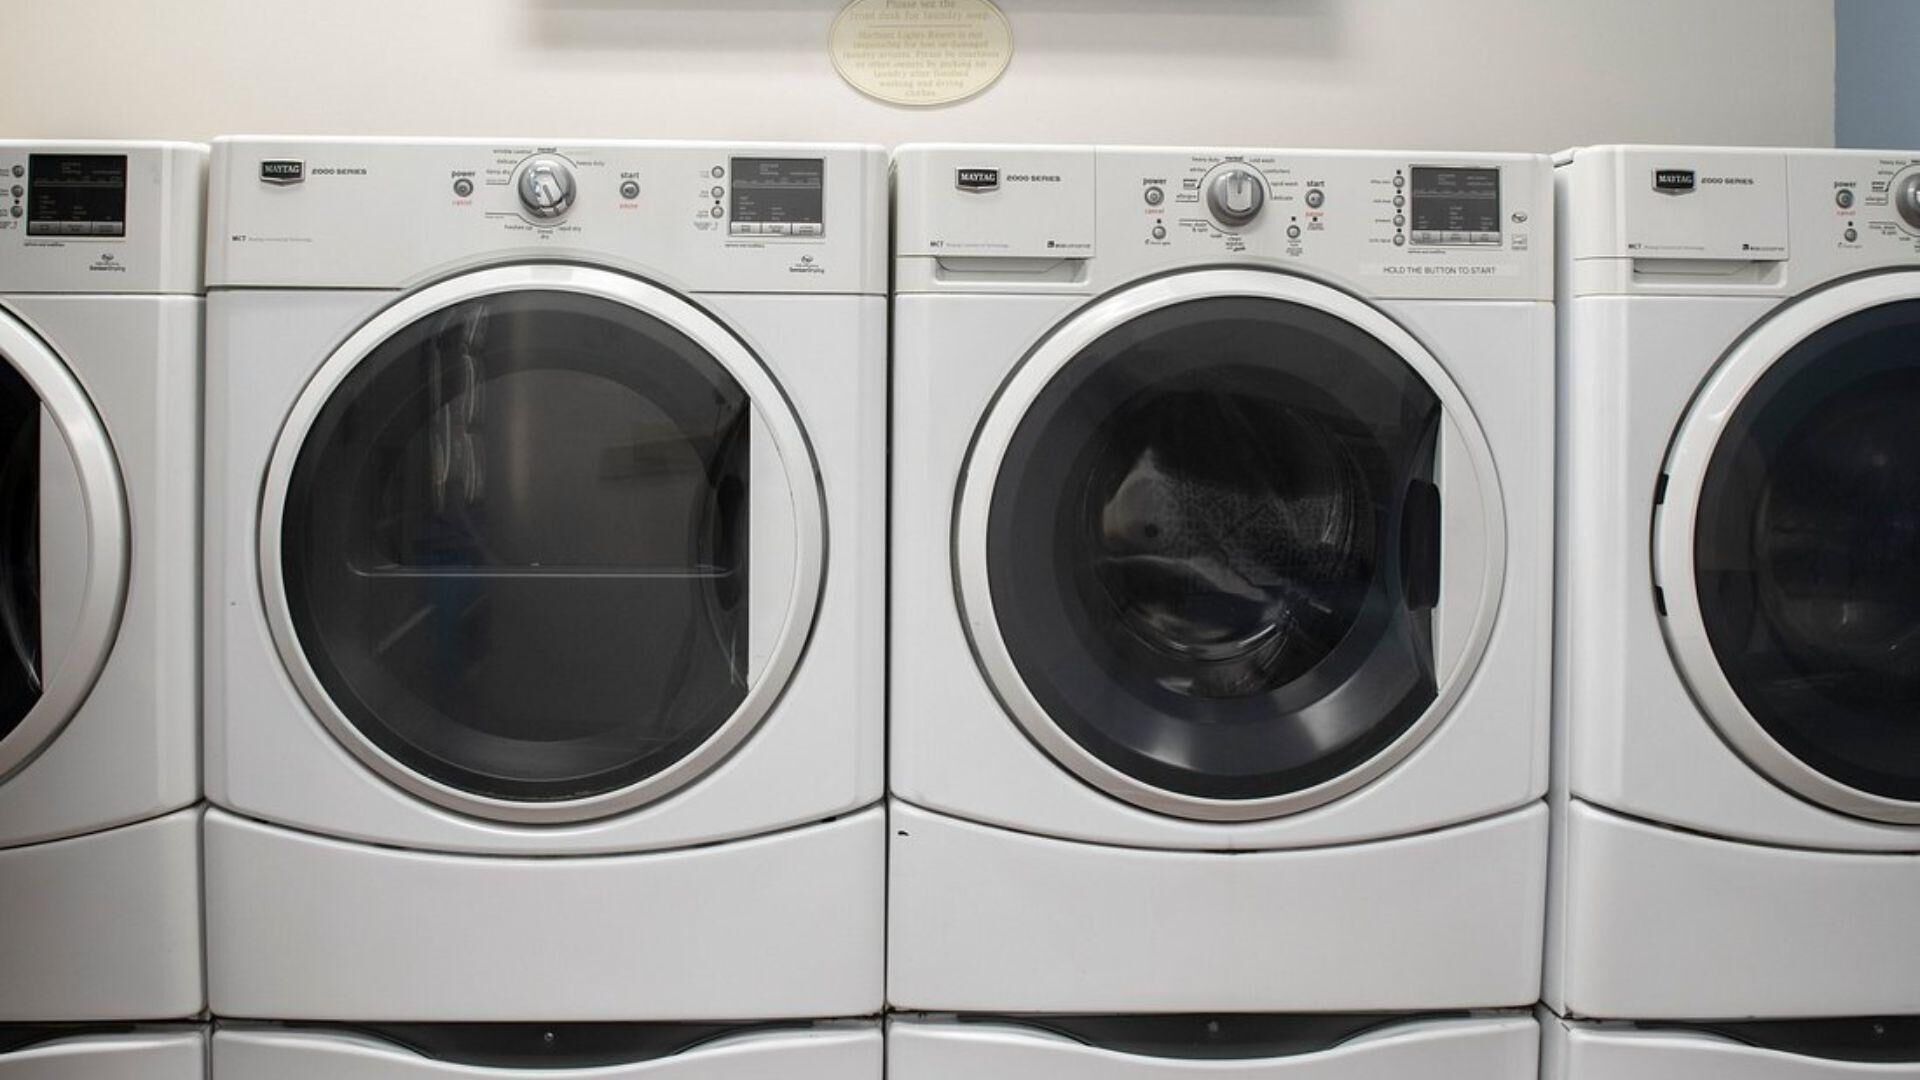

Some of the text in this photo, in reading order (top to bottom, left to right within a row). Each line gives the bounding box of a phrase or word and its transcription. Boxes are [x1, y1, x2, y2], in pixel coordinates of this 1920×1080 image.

[264, 165, 300, 174] MAYTAG
[451, 171, 475, 179] power
[961, 173, 996, 181] MAYTAG
[1659, 174, 1692, 183] MAYTAG
[1143, 178, 1166, 186] power
[1701, 177, 1754, 185] 2000 SERIES
[1383, 267, 1496, 275] HOLD THE BUTTON TO START
